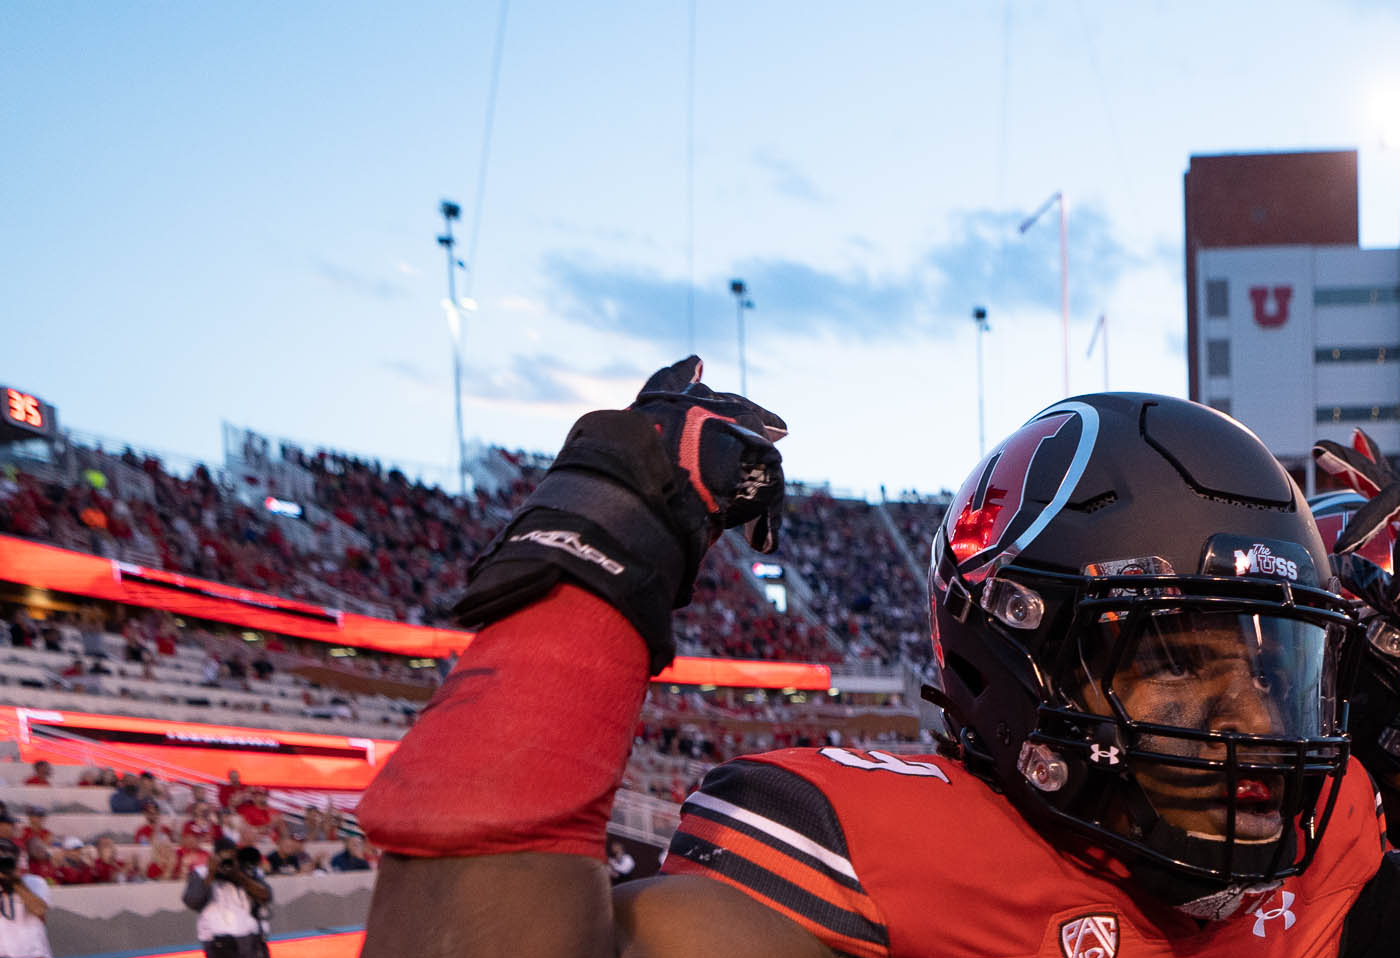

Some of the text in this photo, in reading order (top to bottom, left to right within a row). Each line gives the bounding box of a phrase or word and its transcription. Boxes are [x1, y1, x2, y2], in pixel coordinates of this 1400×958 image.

[7, 387, 43, 428] 35
[1233, 549, 1298, 581] MUSS
[1251, 543, 1272, 557] The
